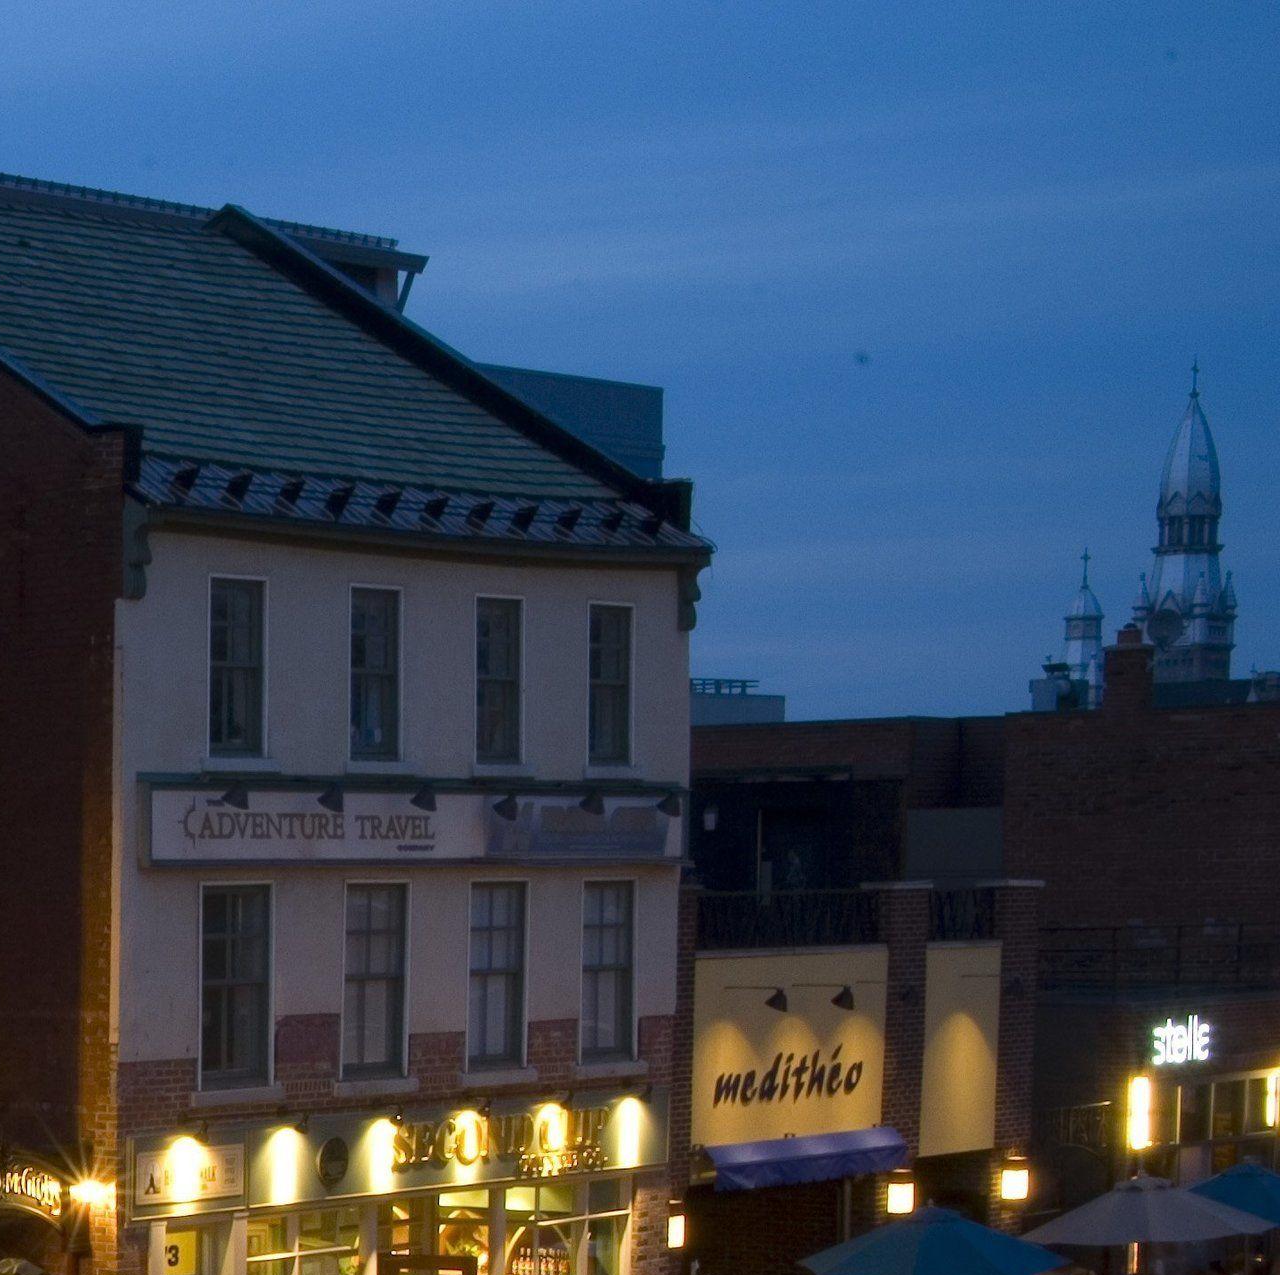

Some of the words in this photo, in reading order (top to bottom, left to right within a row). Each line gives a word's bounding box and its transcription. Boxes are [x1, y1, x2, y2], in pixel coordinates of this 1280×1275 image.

[199, 811, 344, 840] ADVENTURE
[355, 814, 436, 840] TRAVEL
[713, 1042, 863, 1108] medithéo
[164, 1245, 179, 1267] 3
